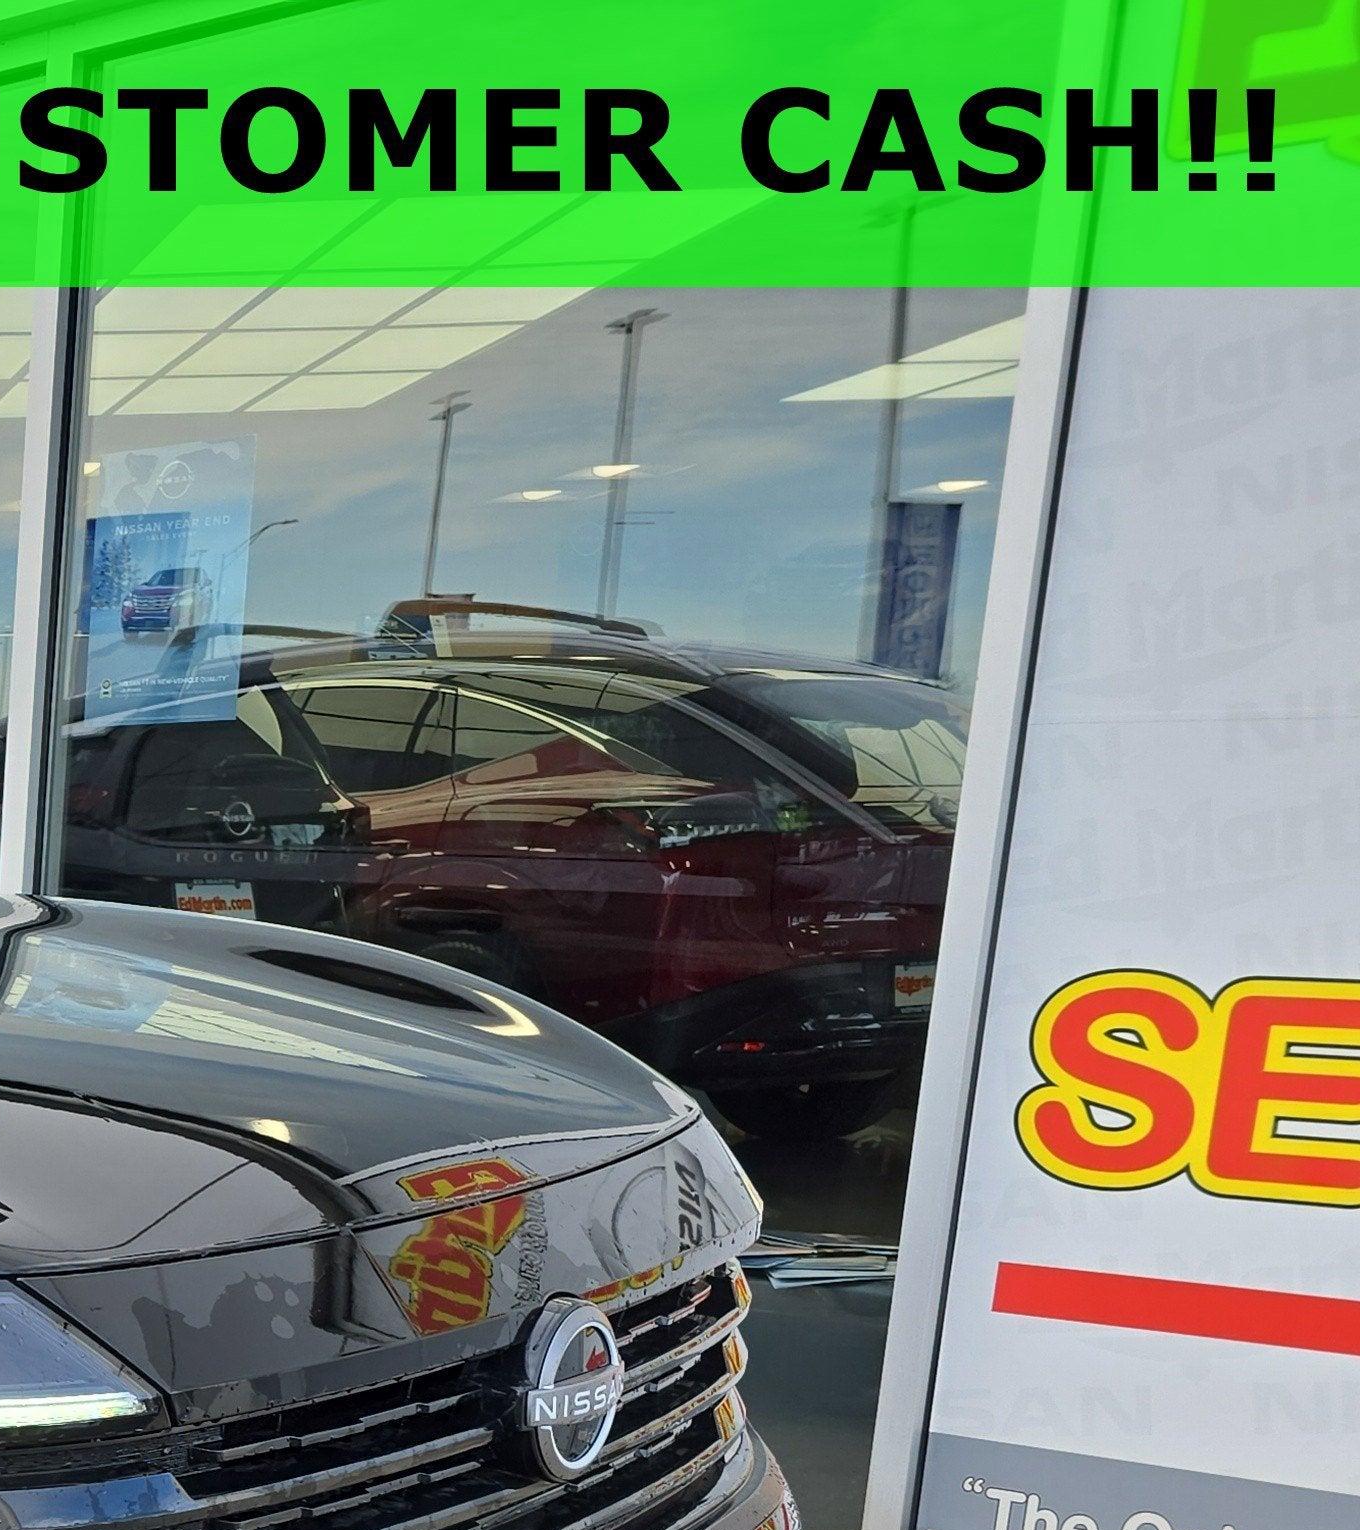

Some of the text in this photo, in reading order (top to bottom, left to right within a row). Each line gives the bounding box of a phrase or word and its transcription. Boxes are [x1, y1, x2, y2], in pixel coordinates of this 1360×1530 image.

[114, 515, 230, 536] NISSAN YEAR END
[176, 850, 292, 864] ROGUE
